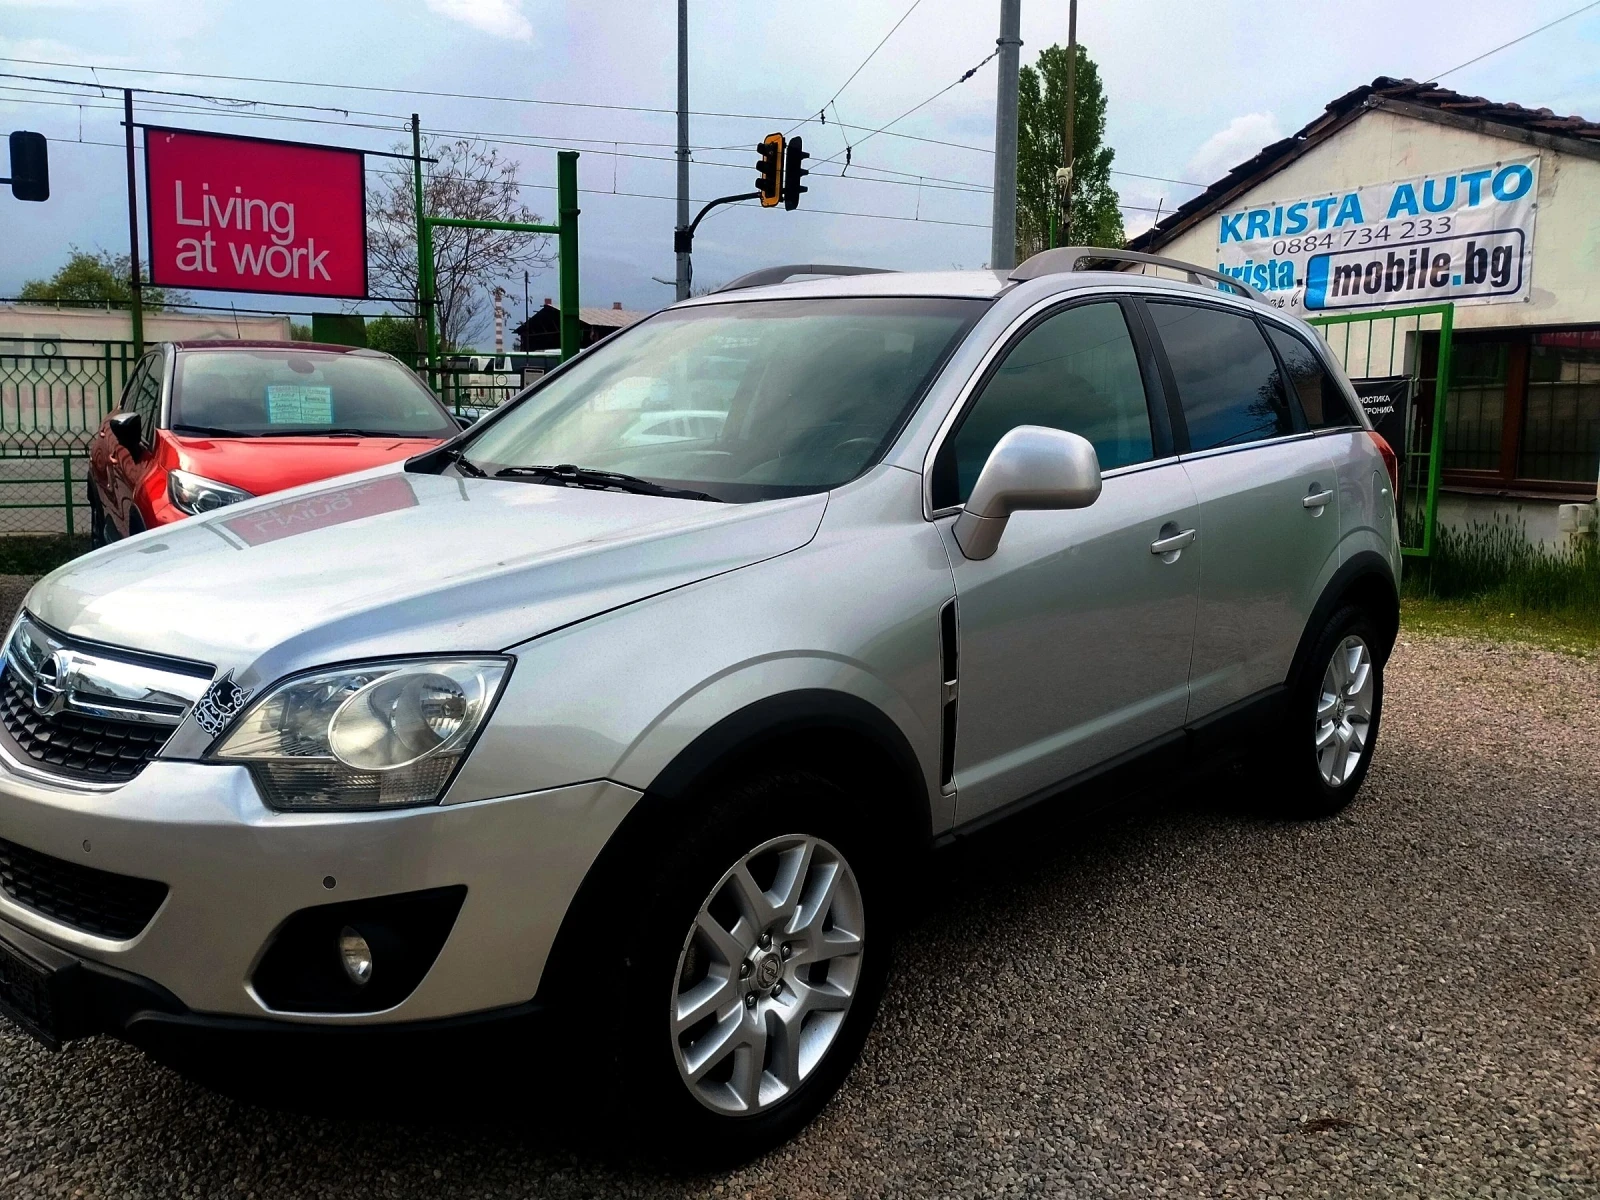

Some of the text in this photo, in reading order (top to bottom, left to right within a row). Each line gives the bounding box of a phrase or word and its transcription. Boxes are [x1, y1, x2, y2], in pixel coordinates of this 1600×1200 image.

[175, 180, 295, 246] Living
[1219, 164, 1533, 244] KRISTA AUTO
[175, 230, 332, 281] at work
[1272, 216, 1452, 256] 0884 734 233
[1331, 240, 1514, 298] mobile.bg
